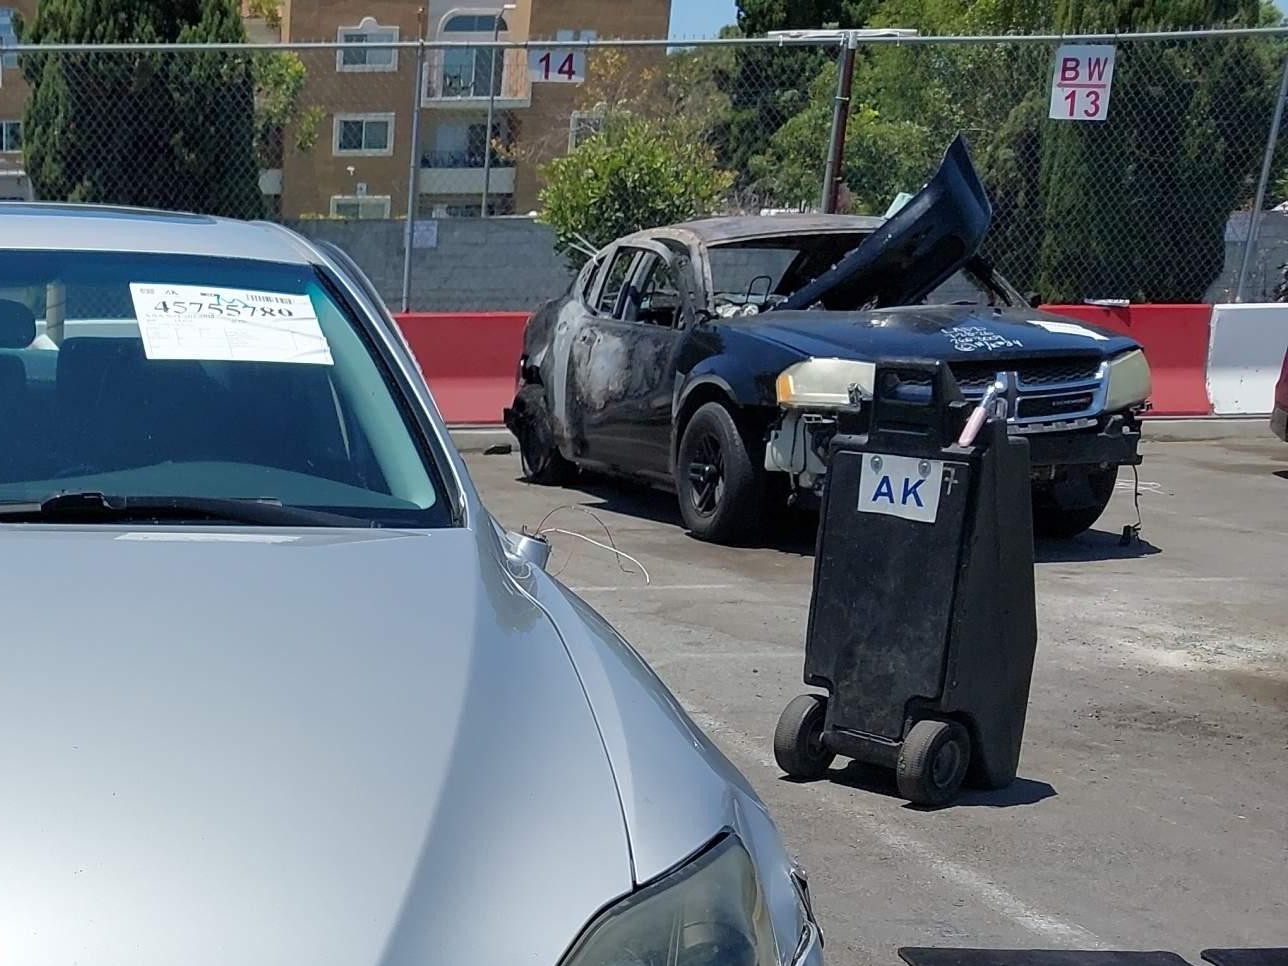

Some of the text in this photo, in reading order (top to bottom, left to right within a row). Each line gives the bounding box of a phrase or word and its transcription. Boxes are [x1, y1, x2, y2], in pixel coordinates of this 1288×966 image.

[539, 52, 576, 80] 14
[1060, 56, 1108, 82] BW
[1064, 90, 1100, 118] 13
[871, 475, 926, 508] AK
